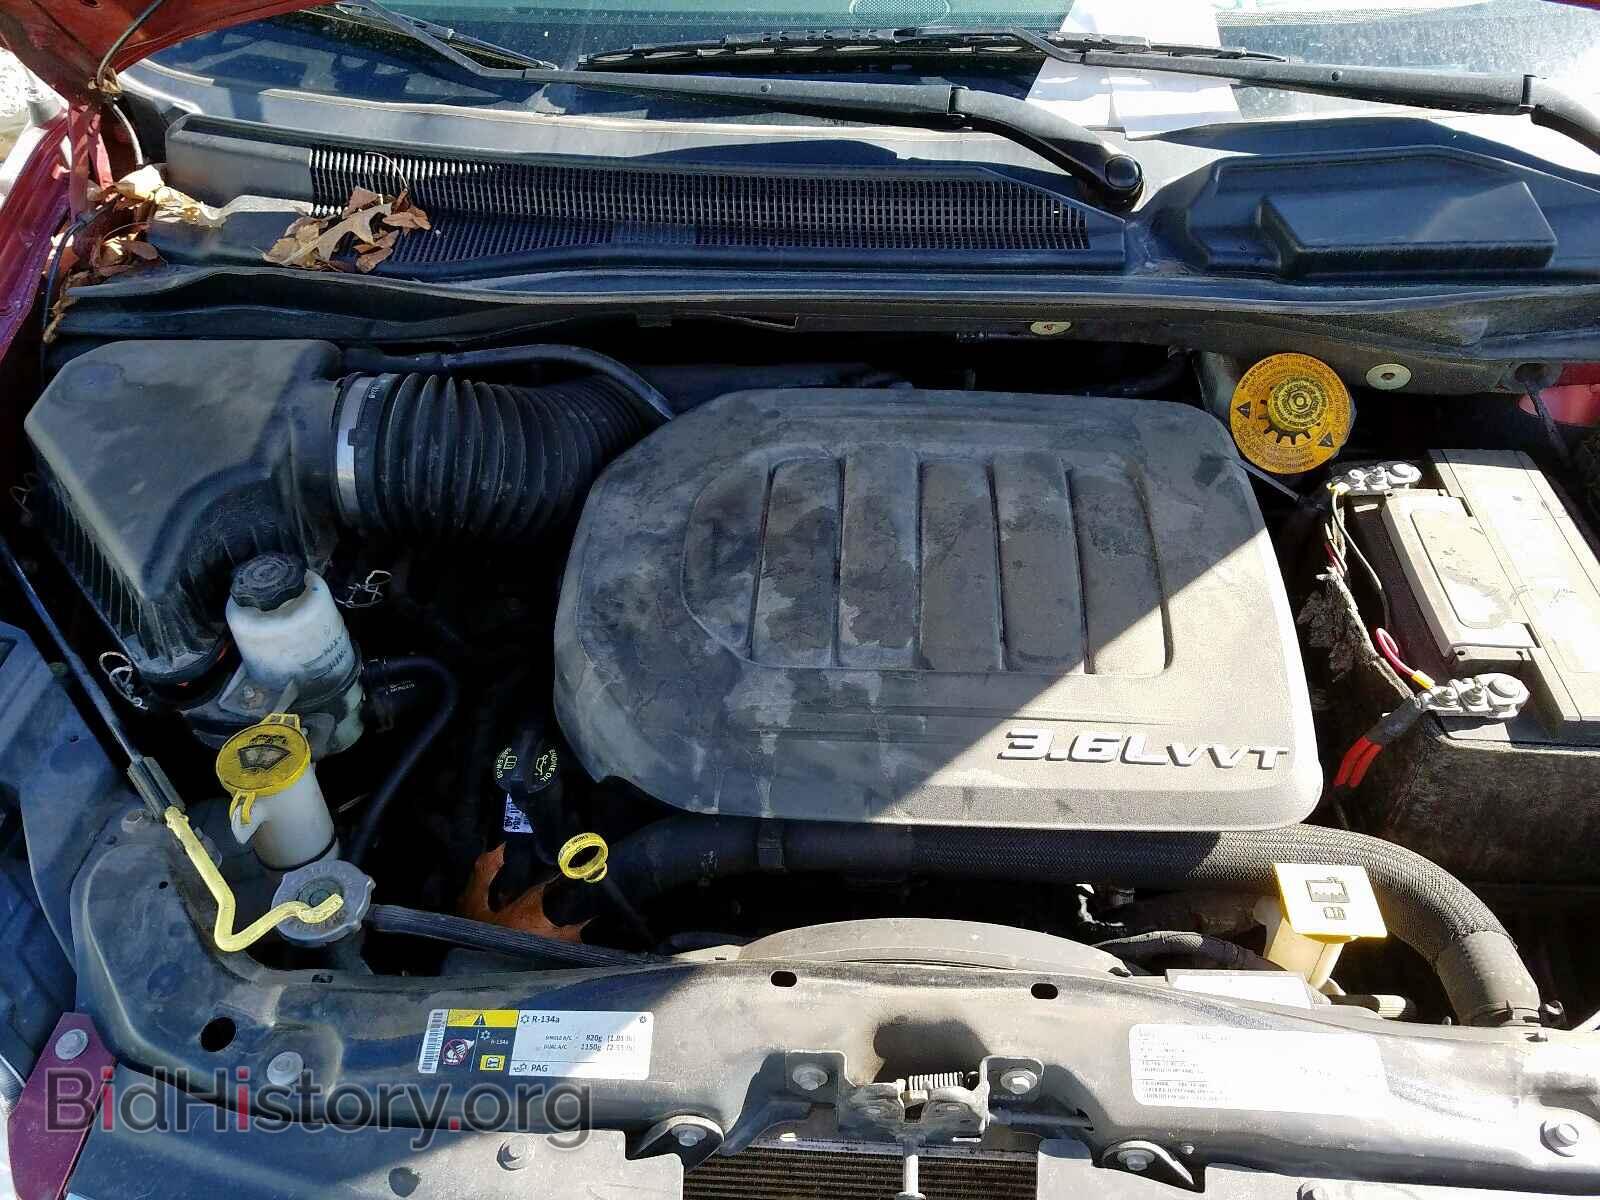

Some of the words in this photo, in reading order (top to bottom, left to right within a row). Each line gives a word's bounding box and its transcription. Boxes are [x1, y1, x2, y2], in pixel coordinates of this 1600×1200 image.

[549, 748, 558, 773] ENGINE
[540, 772, 552, 782] OIL
[531, 1015, 560, 1024] R-134a
[586, 1034, 602, 1043] 820g
[580, 1044, 602, 1052] 1150g
[531, 1064, 549, 1072] PAG
